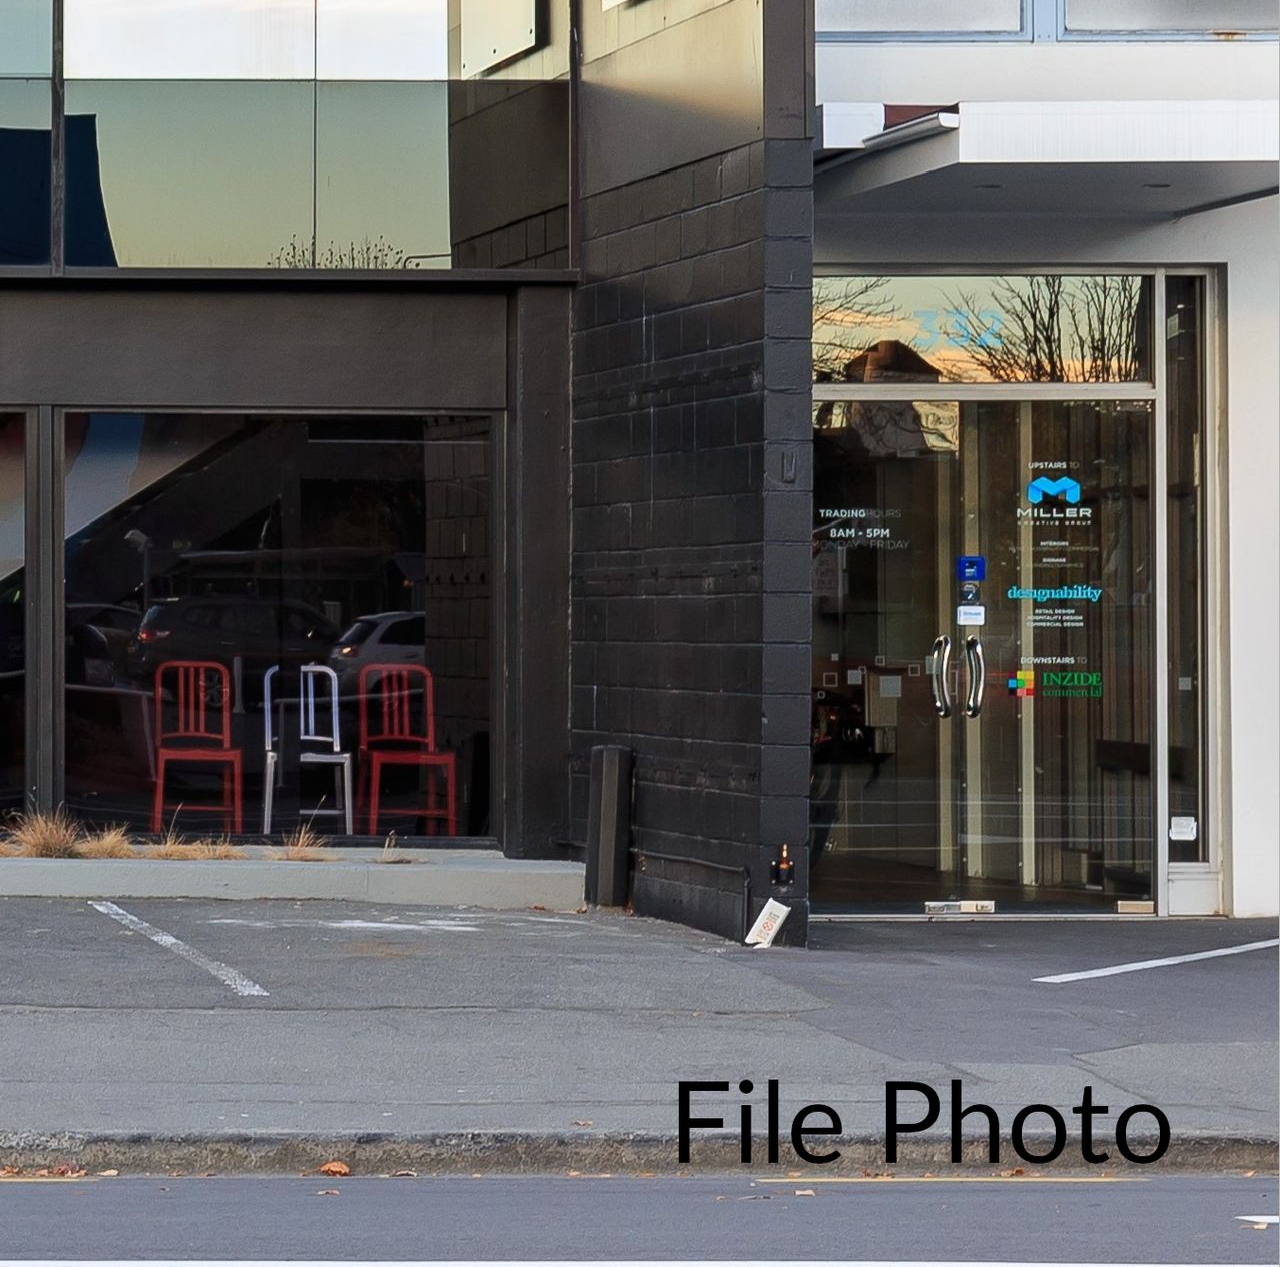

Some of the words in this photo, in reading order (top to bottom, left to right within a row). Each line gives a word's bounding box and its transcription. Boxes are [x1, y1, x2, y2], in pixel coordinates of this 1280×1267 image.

[1028, 461, 1067, 469] UPSTAIRS
[819, 508, 866, 518] TRADING
[1016, 507, 1093, 519] MILLER
[830, 528, 855, 538] 8AM
[866, 528, 890, 538] 5PM
[869, 540, 910, 550] FRIDAY
[1007, 584, 1103, 603] designability
[1020, 656, 1075, 664] DOWNSTAIRS
[1076, 656, 1088, 664] TO
[1042, 672, 1103, 686] INZIDE
